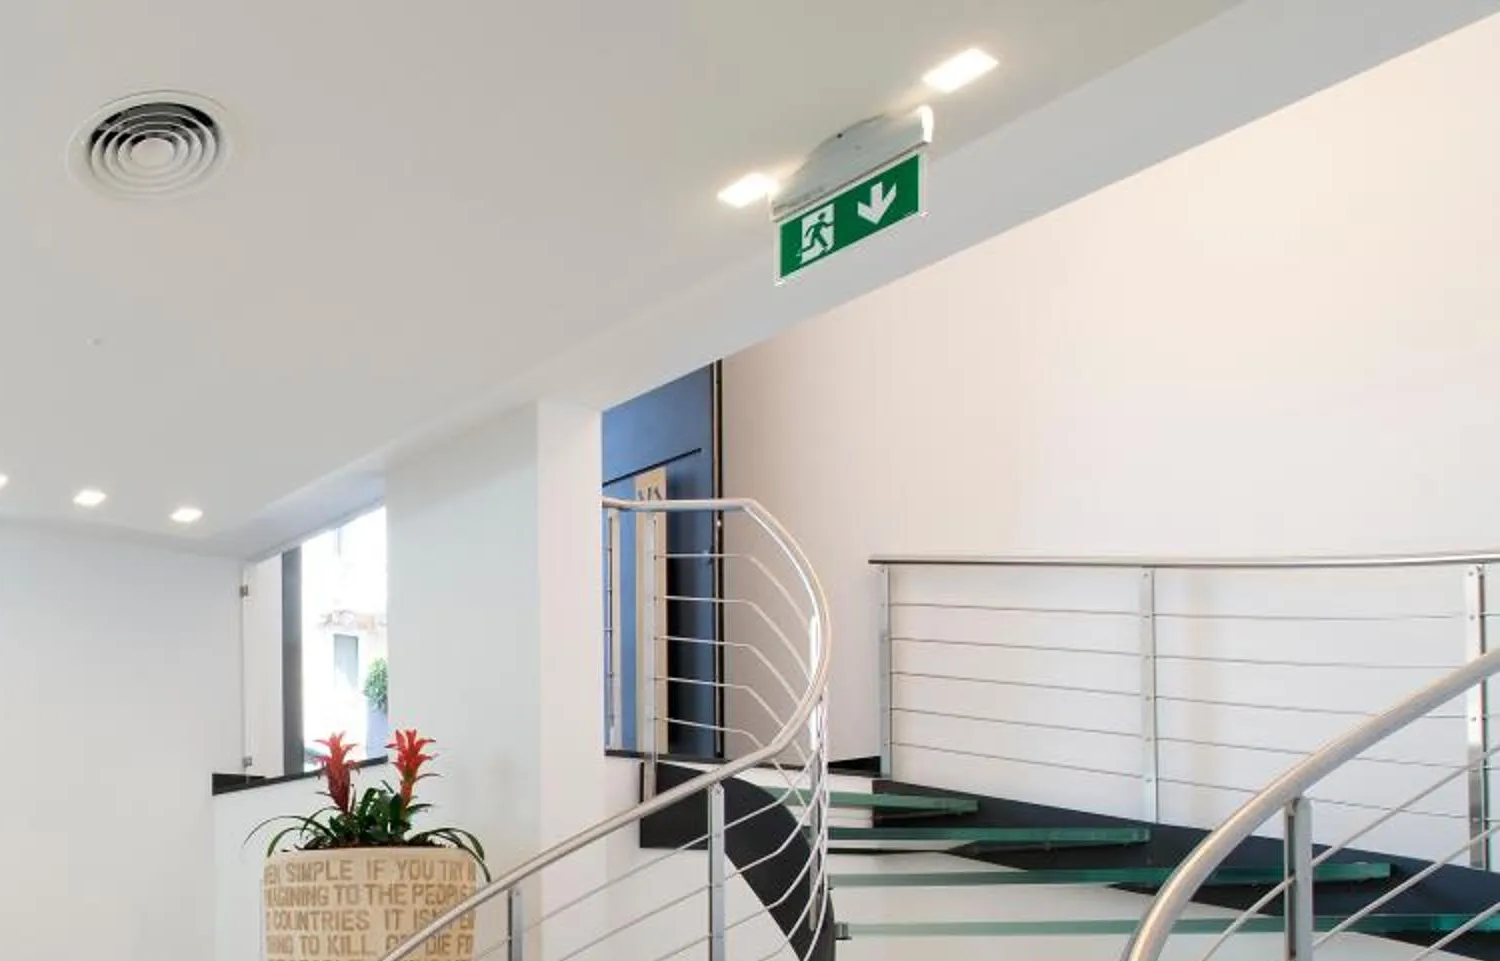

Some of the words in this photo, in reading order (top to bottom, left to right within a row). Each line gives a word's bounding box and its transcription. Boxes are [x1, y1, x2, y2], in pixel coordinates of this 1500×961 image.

[286, 859, 353, 883] SIMPLE
[367, 860, 385, 881] IF
[396, 859, 432, 881] YOU
[333, 884, 357, 905] TO
[359, 884, 408, 906] THE
[384, 909, 405, 932] IT
[301, 936, 320, 956] TO
[328, 935, 377, 955] KILL
[425, 935, 451, 955] DIE
